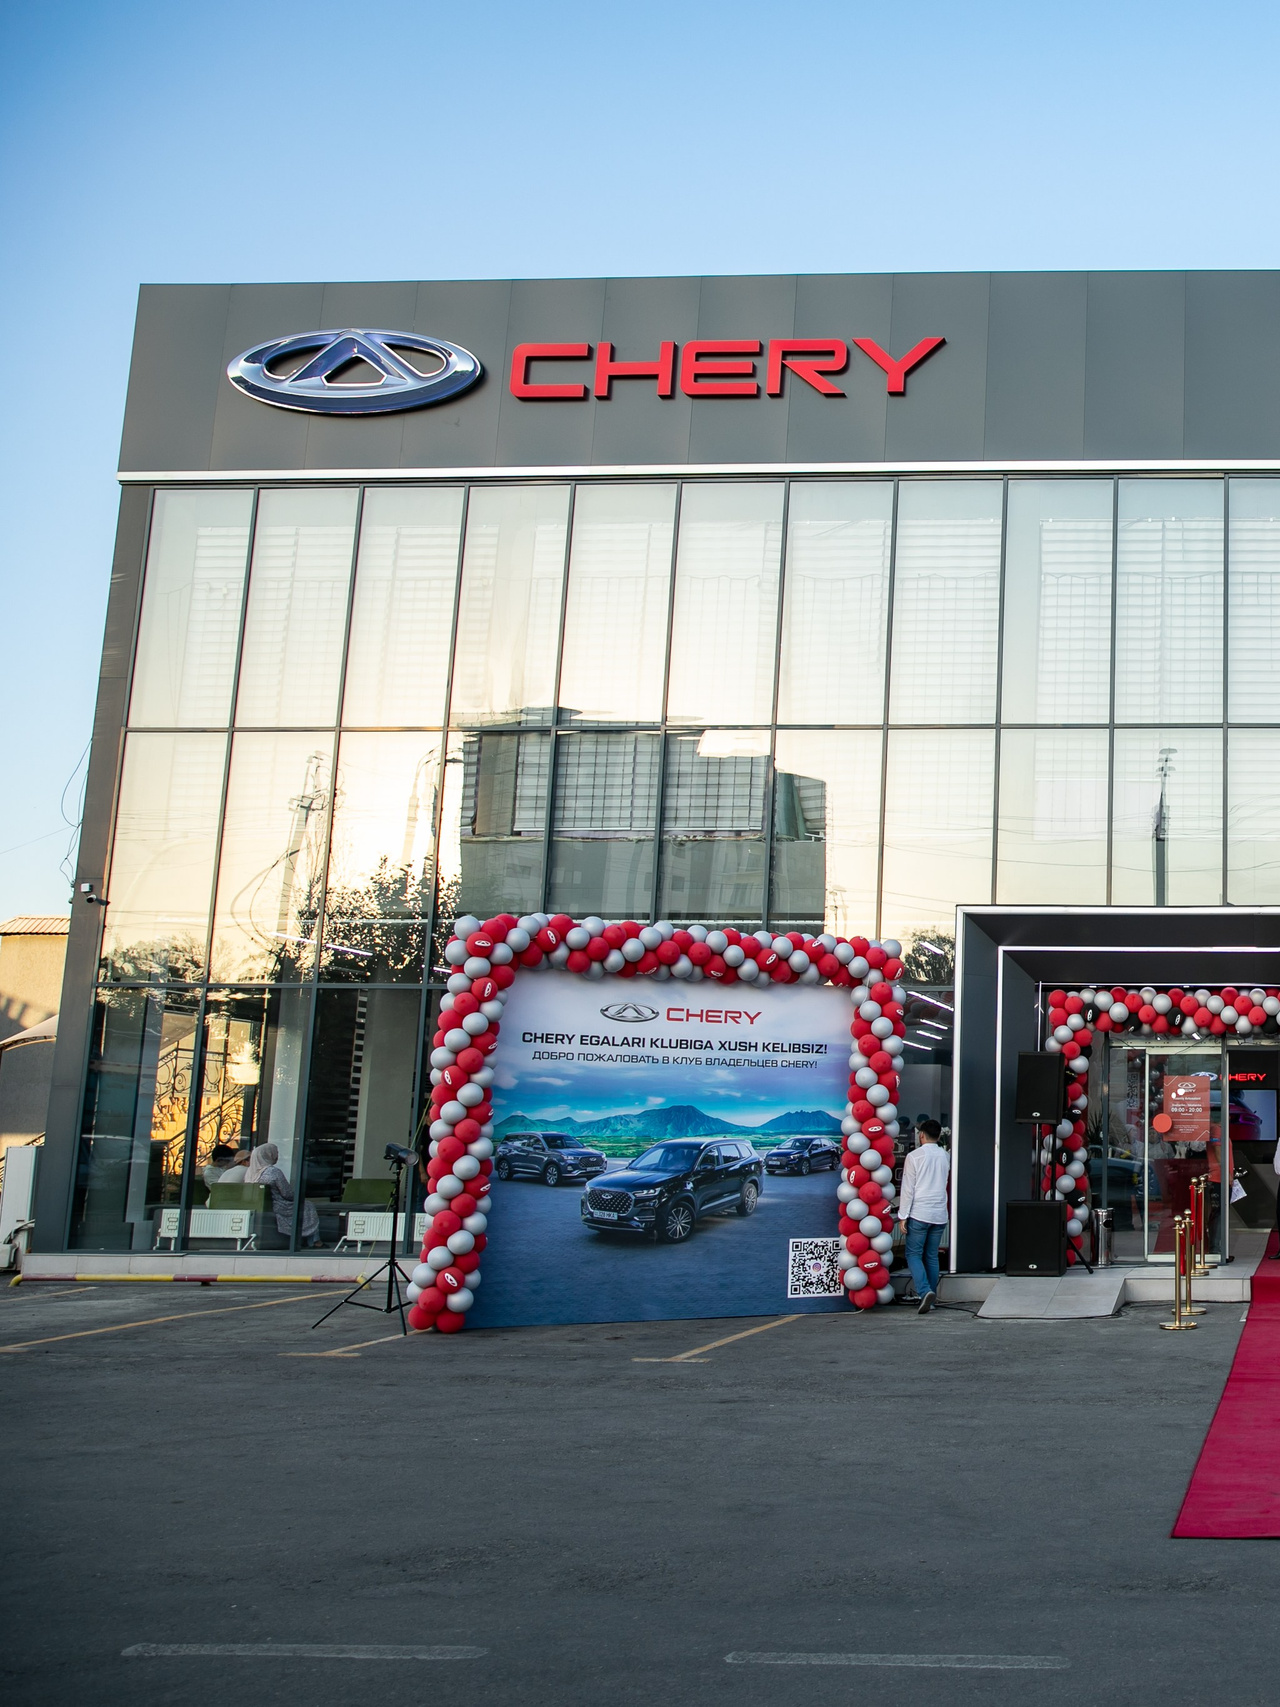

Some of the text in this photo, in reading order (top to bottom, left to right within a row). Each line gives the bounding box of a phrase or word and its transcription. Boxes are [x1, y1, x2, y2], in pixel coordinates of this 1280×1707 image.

[509, 337, 946, 400] CHERY
[666, 1007, 762, 1025] CHERY
[522, 1031, 828, 1054] CHERY EGALARI KLUBIGA XUSH KELIBSIZ!
[532, 1051, 818, 1069] ДОБРО ПОЖАЛОВАТЬ В КЛУБ ВЛАДЕЛЬЦЕВ CHERY!
